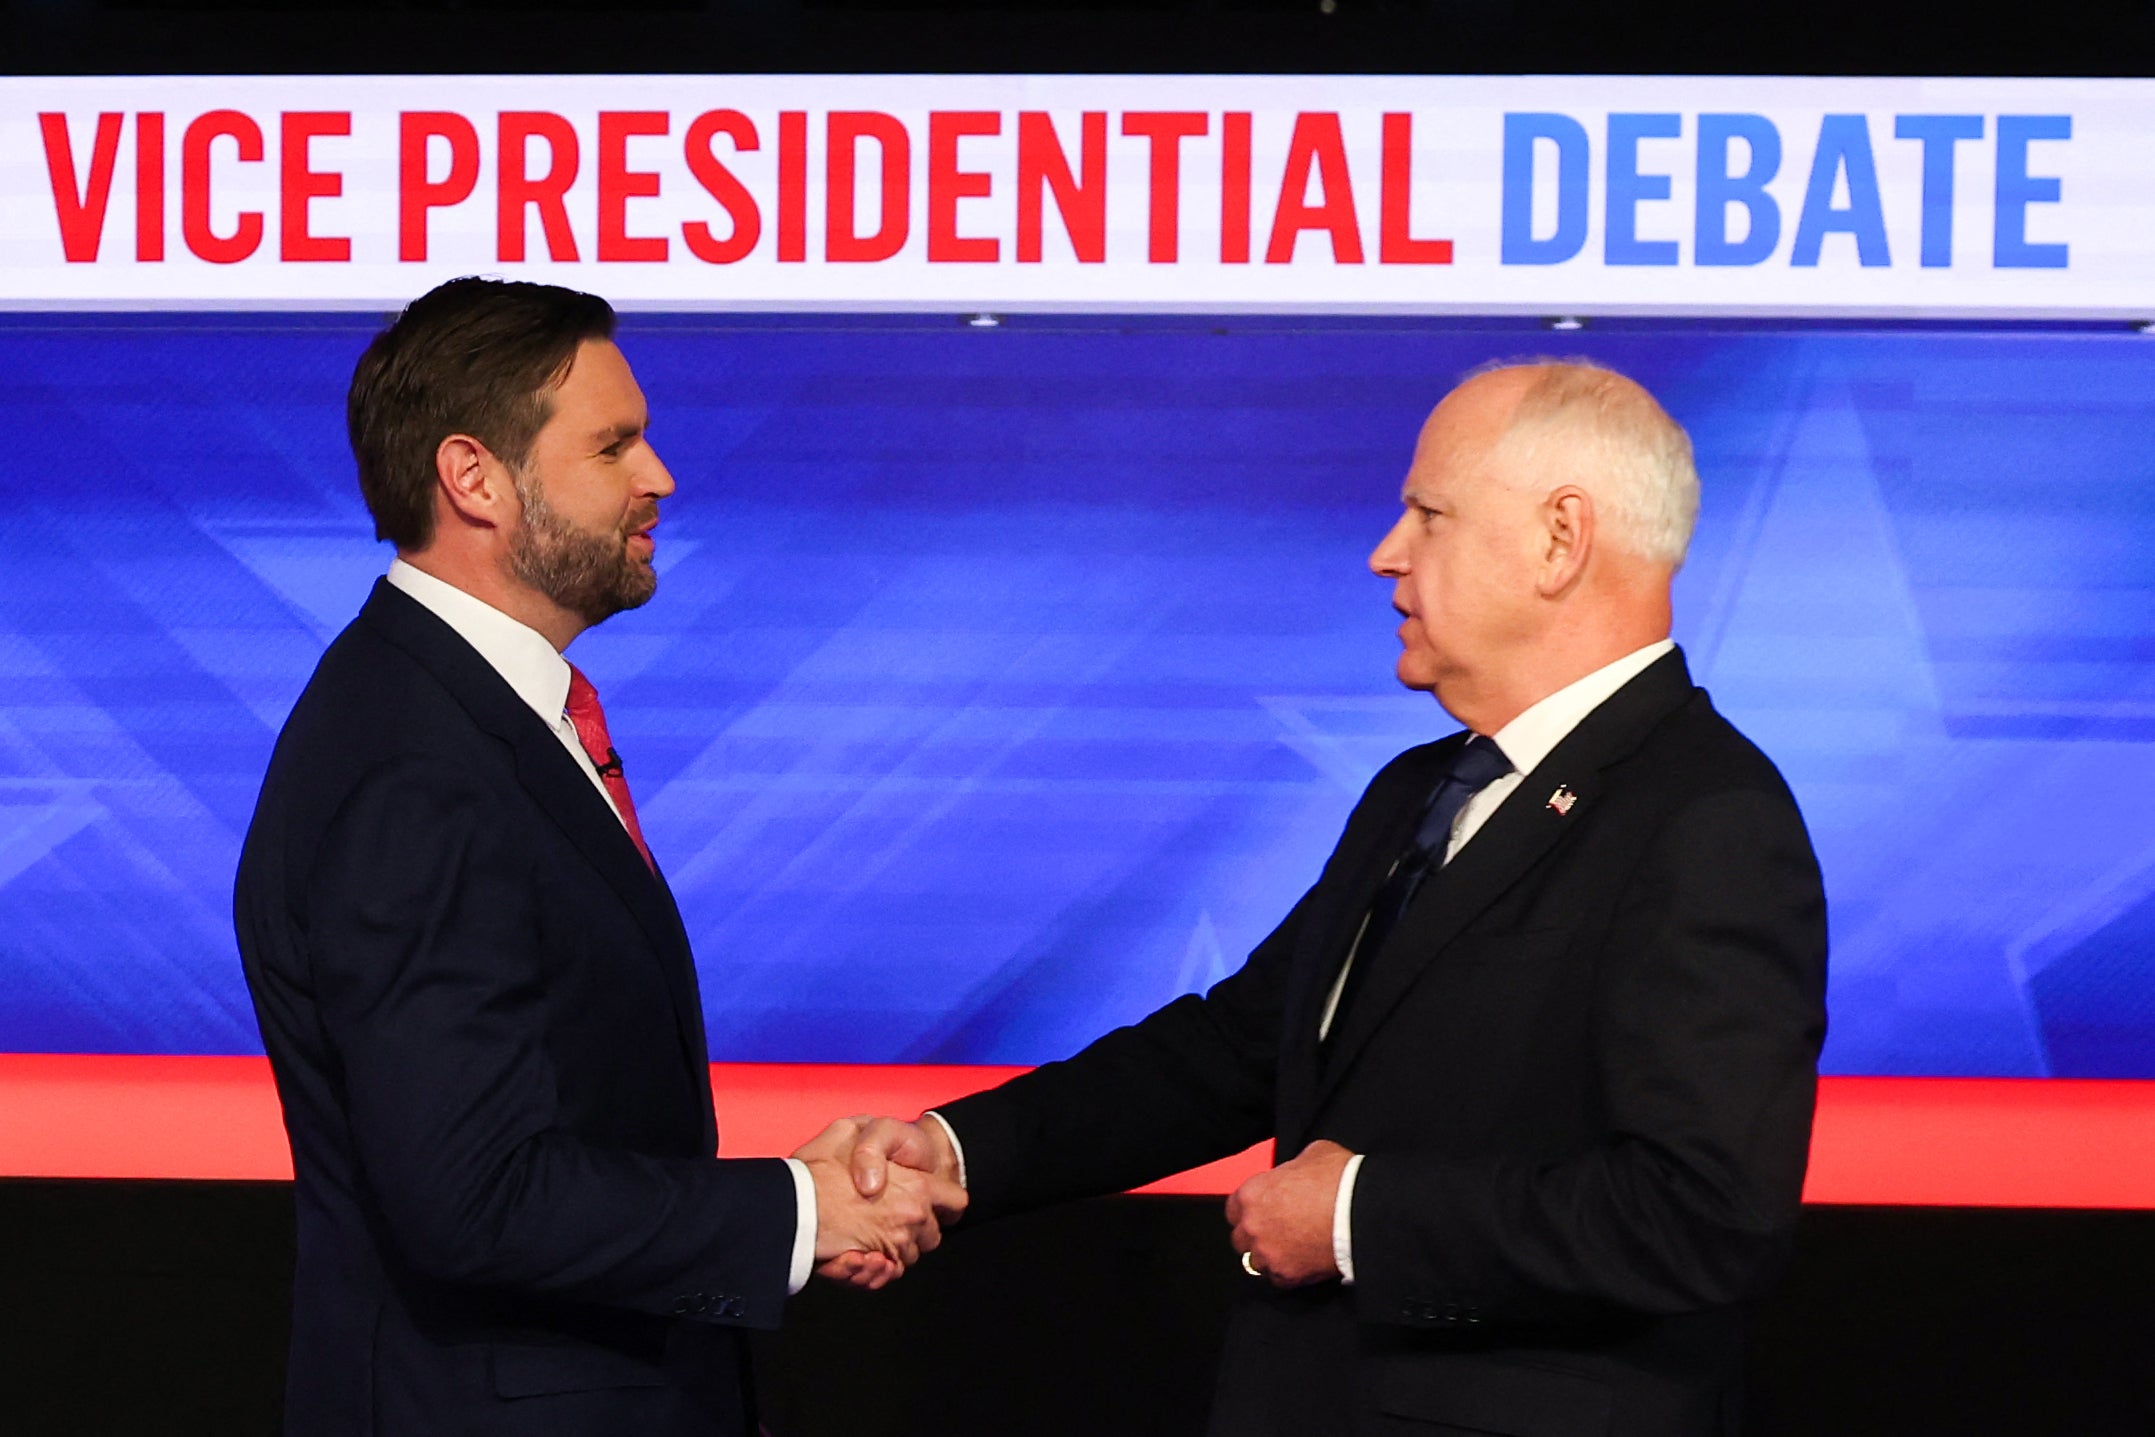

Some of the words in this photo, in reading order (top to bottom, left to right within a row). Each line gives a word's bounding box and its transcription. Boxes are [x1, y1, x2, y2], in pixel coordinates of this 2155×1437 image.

[39, 109, 352, 264] VICE
[399, 109, 1453, 265] PRESIDENTIAL
[1501, 113, 2072, 268] DEBATE
